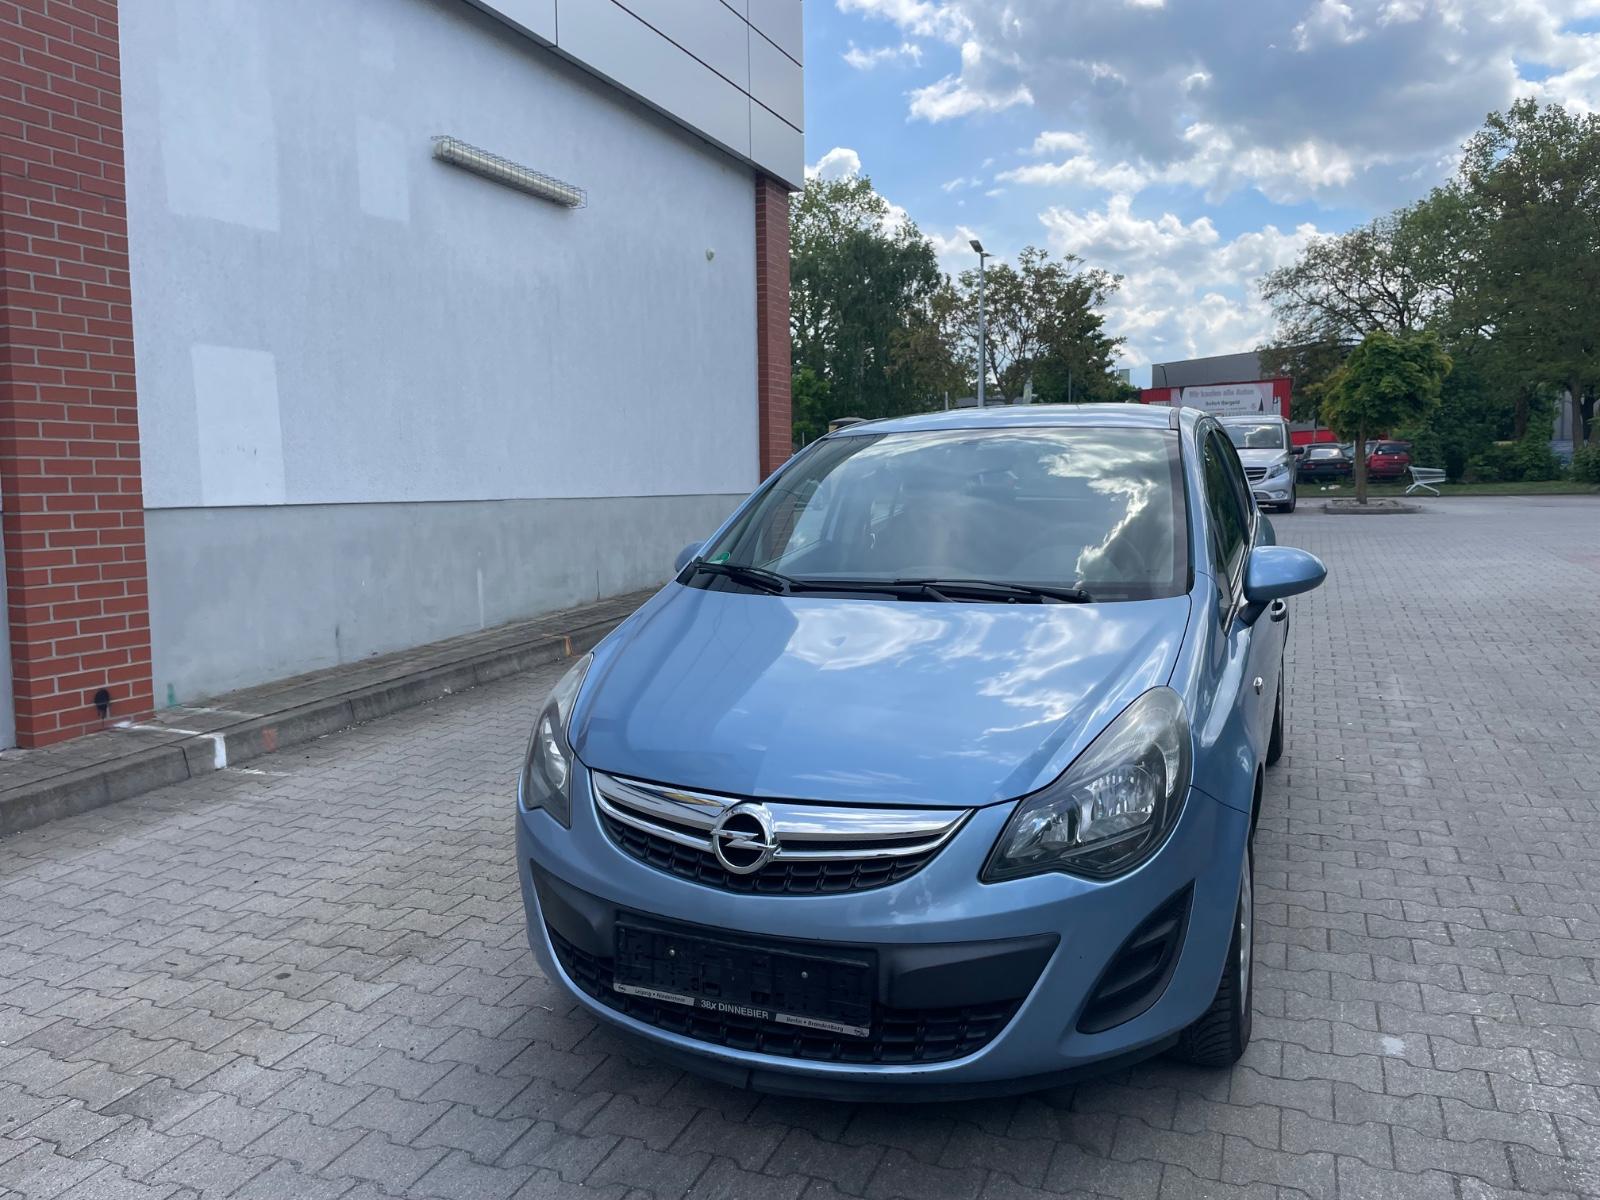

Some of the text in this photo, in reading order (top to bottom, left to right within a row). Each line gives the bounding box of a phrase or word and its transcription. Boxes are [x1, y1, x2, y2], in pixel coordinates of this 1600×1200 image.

[635, 989, 652, 997] Leipzig
[718, 1003, 769, 1020] DINNEBIER
[786, 1017, 844, 1032] Berlin Brandenburg
